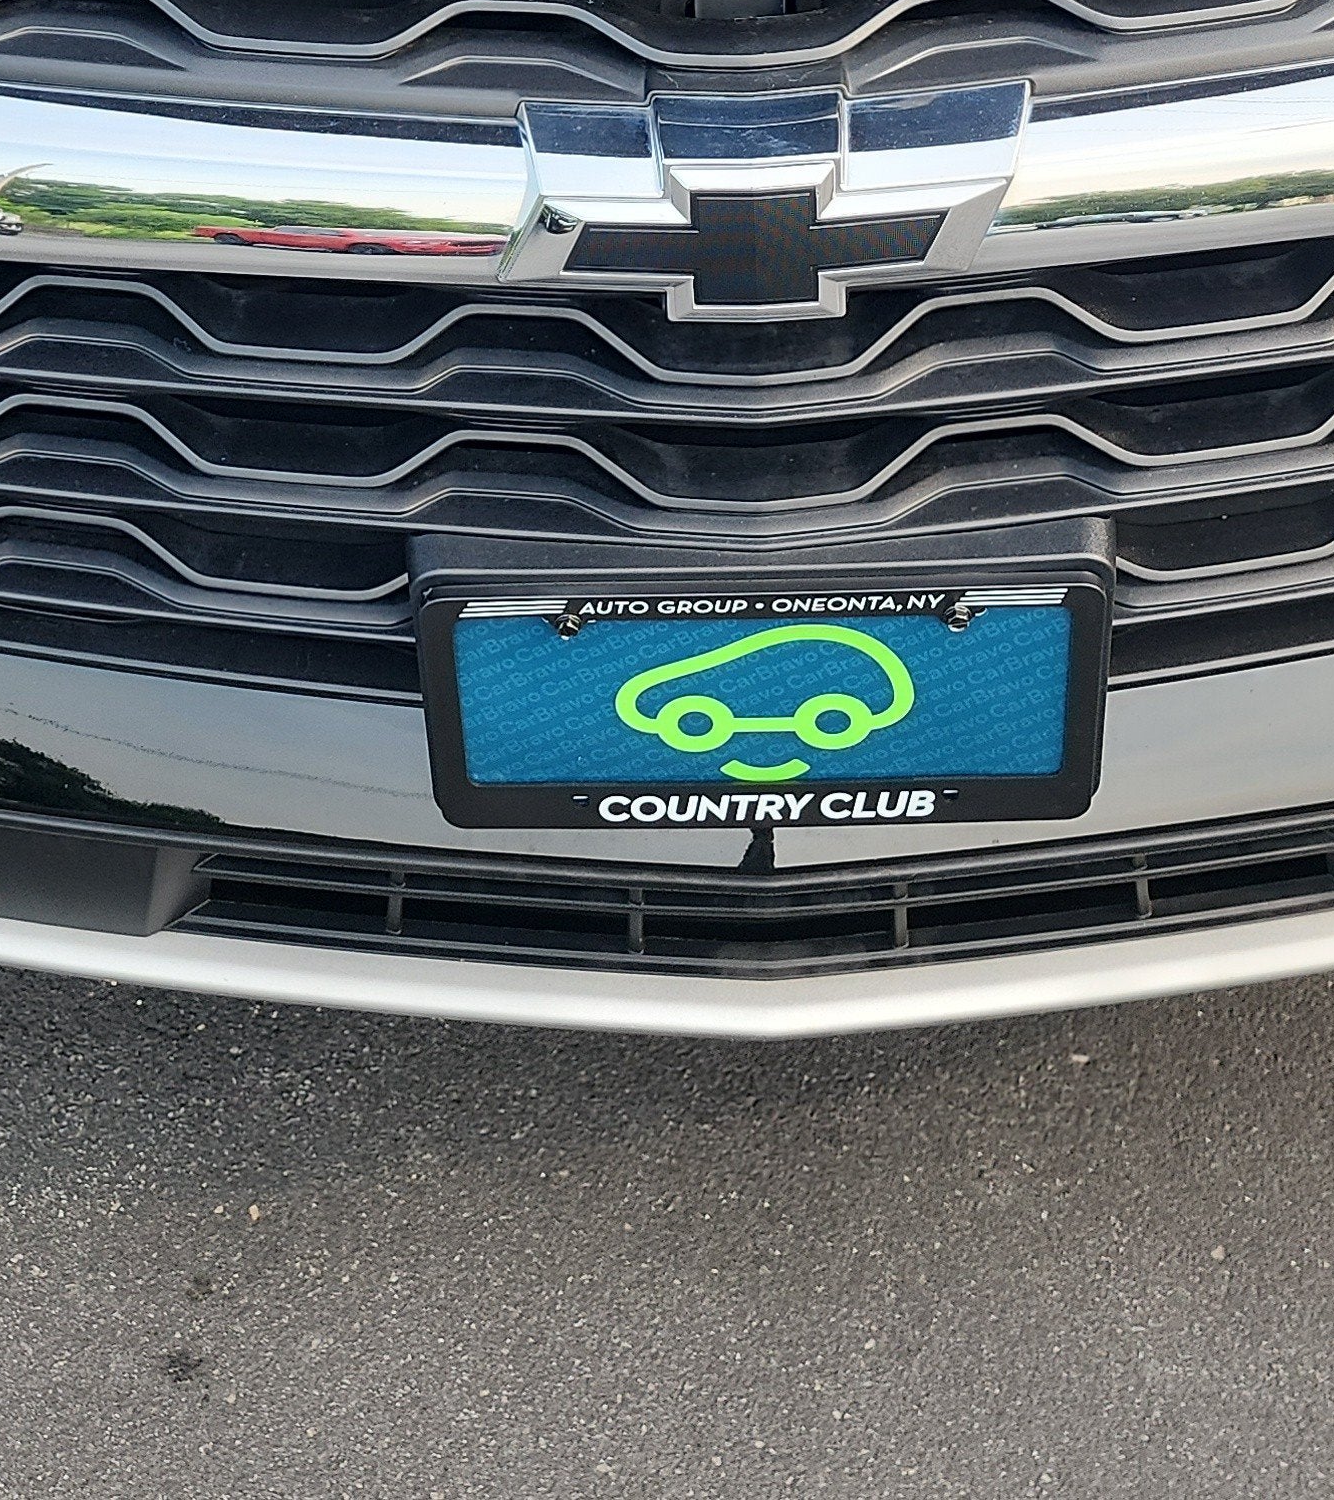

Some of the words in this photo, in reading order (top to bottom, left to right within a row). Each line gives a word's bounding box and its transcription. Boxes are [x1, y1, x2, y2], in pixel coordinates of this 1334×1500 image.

[578, 601, 649, 615] AUTO
[657, 600, 748, 614] GROUP
[906, 594, 945, 609] NY
[598, 793, 815, 822] COUNTRY
[820, 791, 935, 819] CLUB
